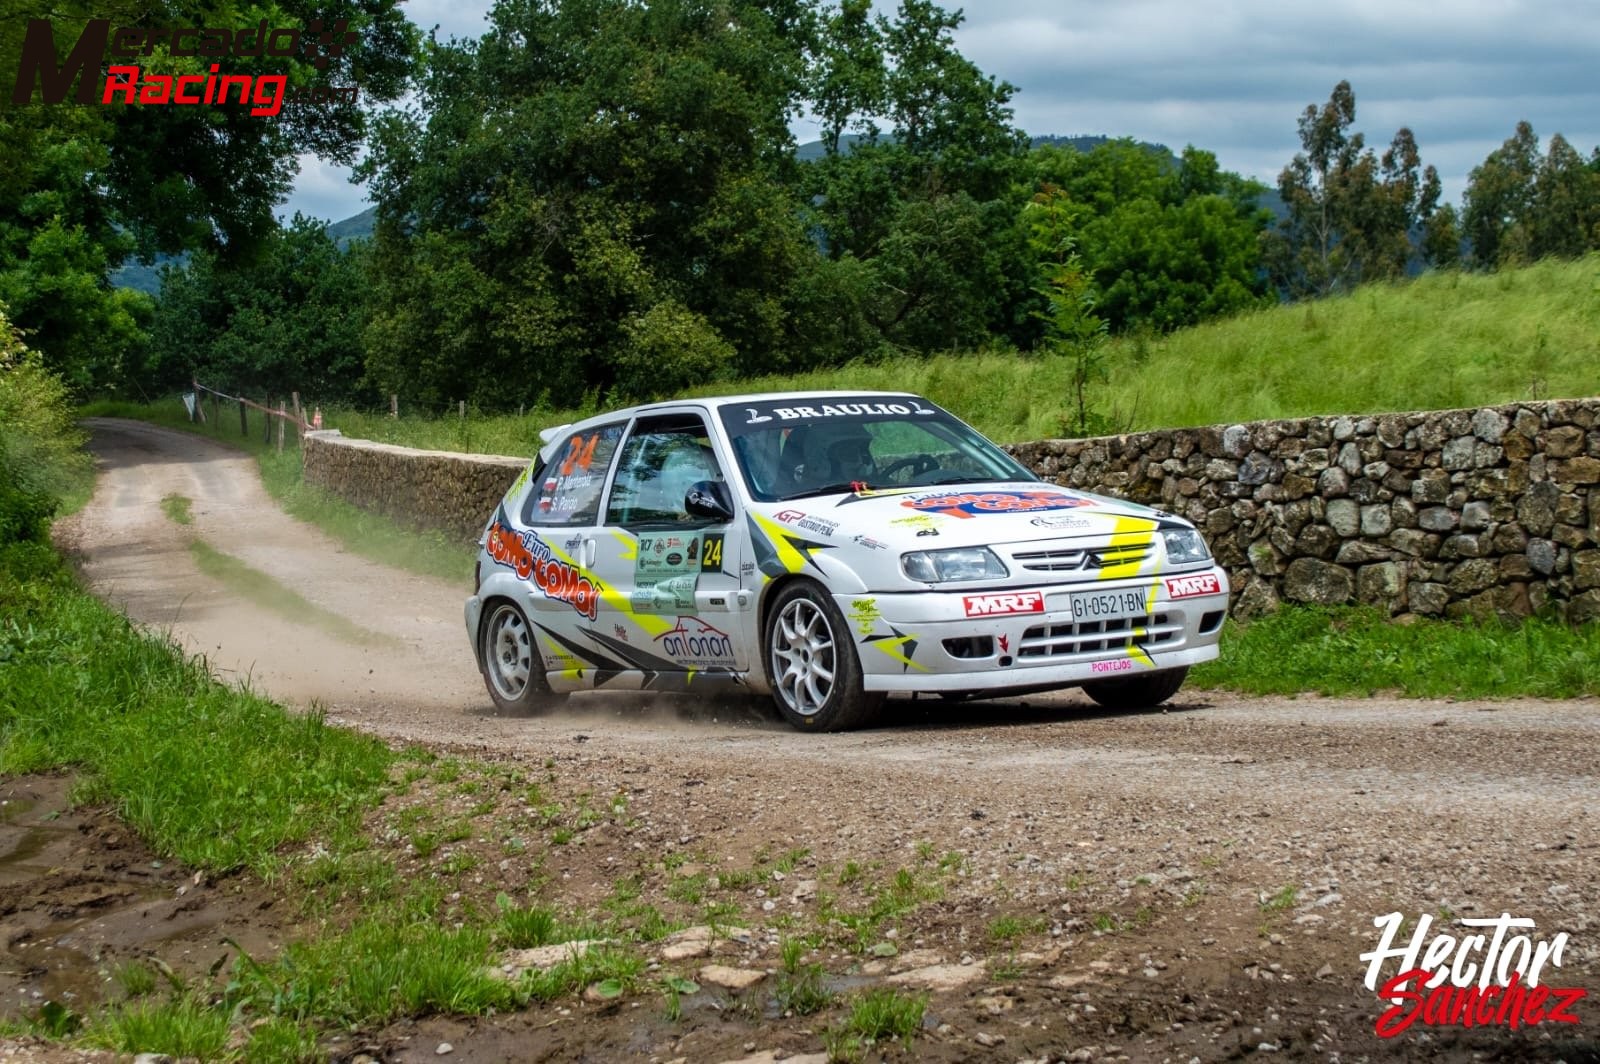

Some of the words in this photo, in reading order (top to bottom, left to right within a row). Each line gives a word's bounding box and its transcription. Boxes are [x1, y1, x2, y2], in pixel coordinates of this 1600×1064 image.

[773, 404, 911, 420] BRAULIO
[560, 432, 601, 476] 24
[703, 539, 722, 566] 24
[1169, 576, 1219, 597] MRF
[967, 594, 1038, 616] MRF
[1092, 660, 1132, 672] PONTEJOS
